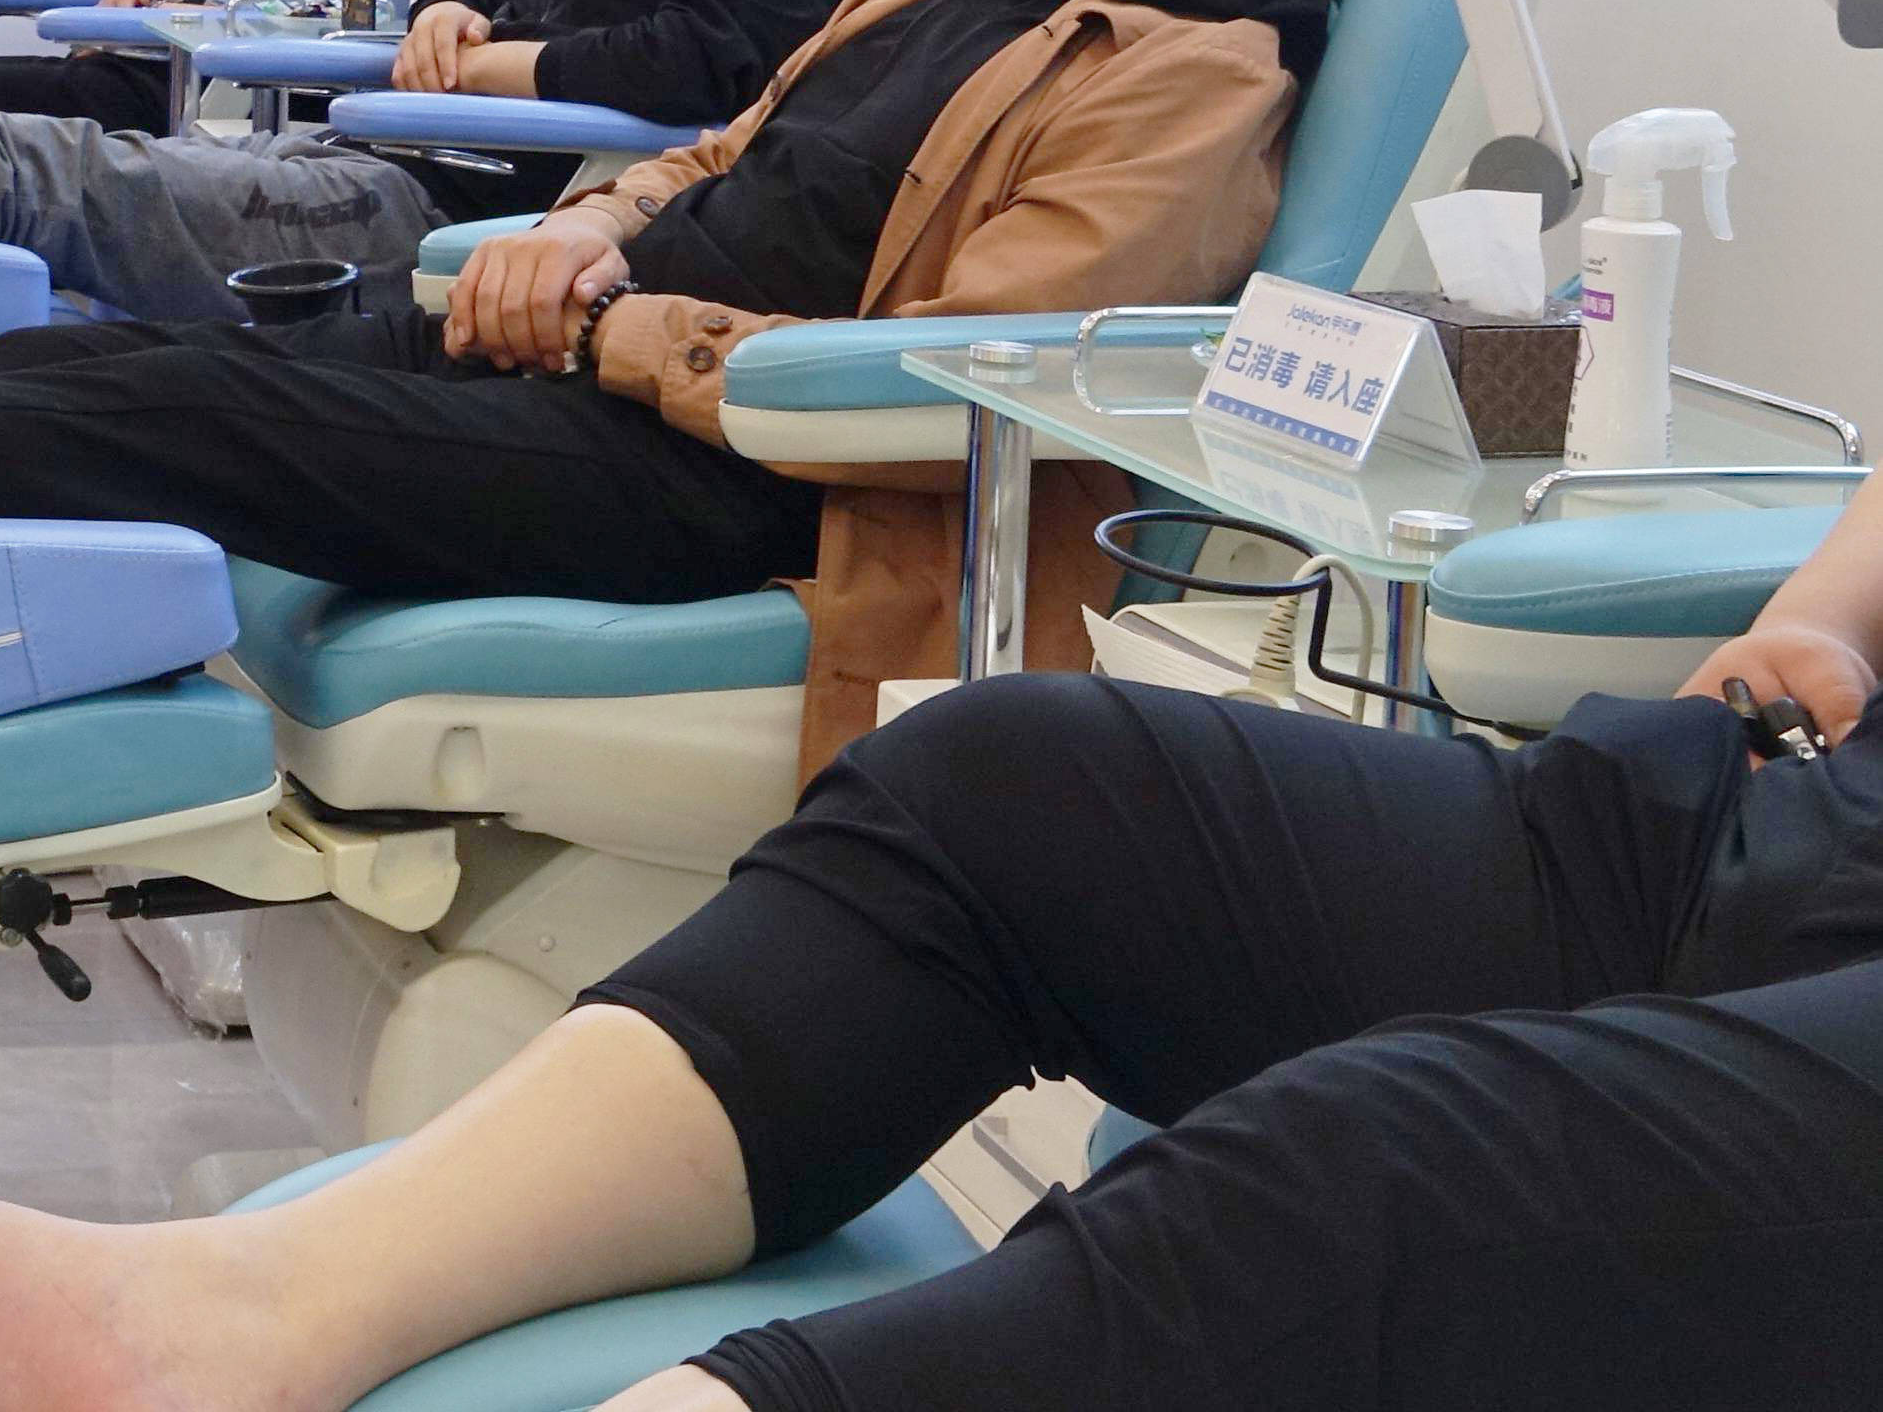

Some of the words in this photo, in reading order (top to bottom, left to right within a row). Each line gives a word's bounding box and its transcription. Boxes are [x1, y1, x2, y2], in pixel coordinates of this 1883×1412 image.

[1224, 336, 1302, 389] 已消毒
[1303, 360, 1386, 416] 请入座
